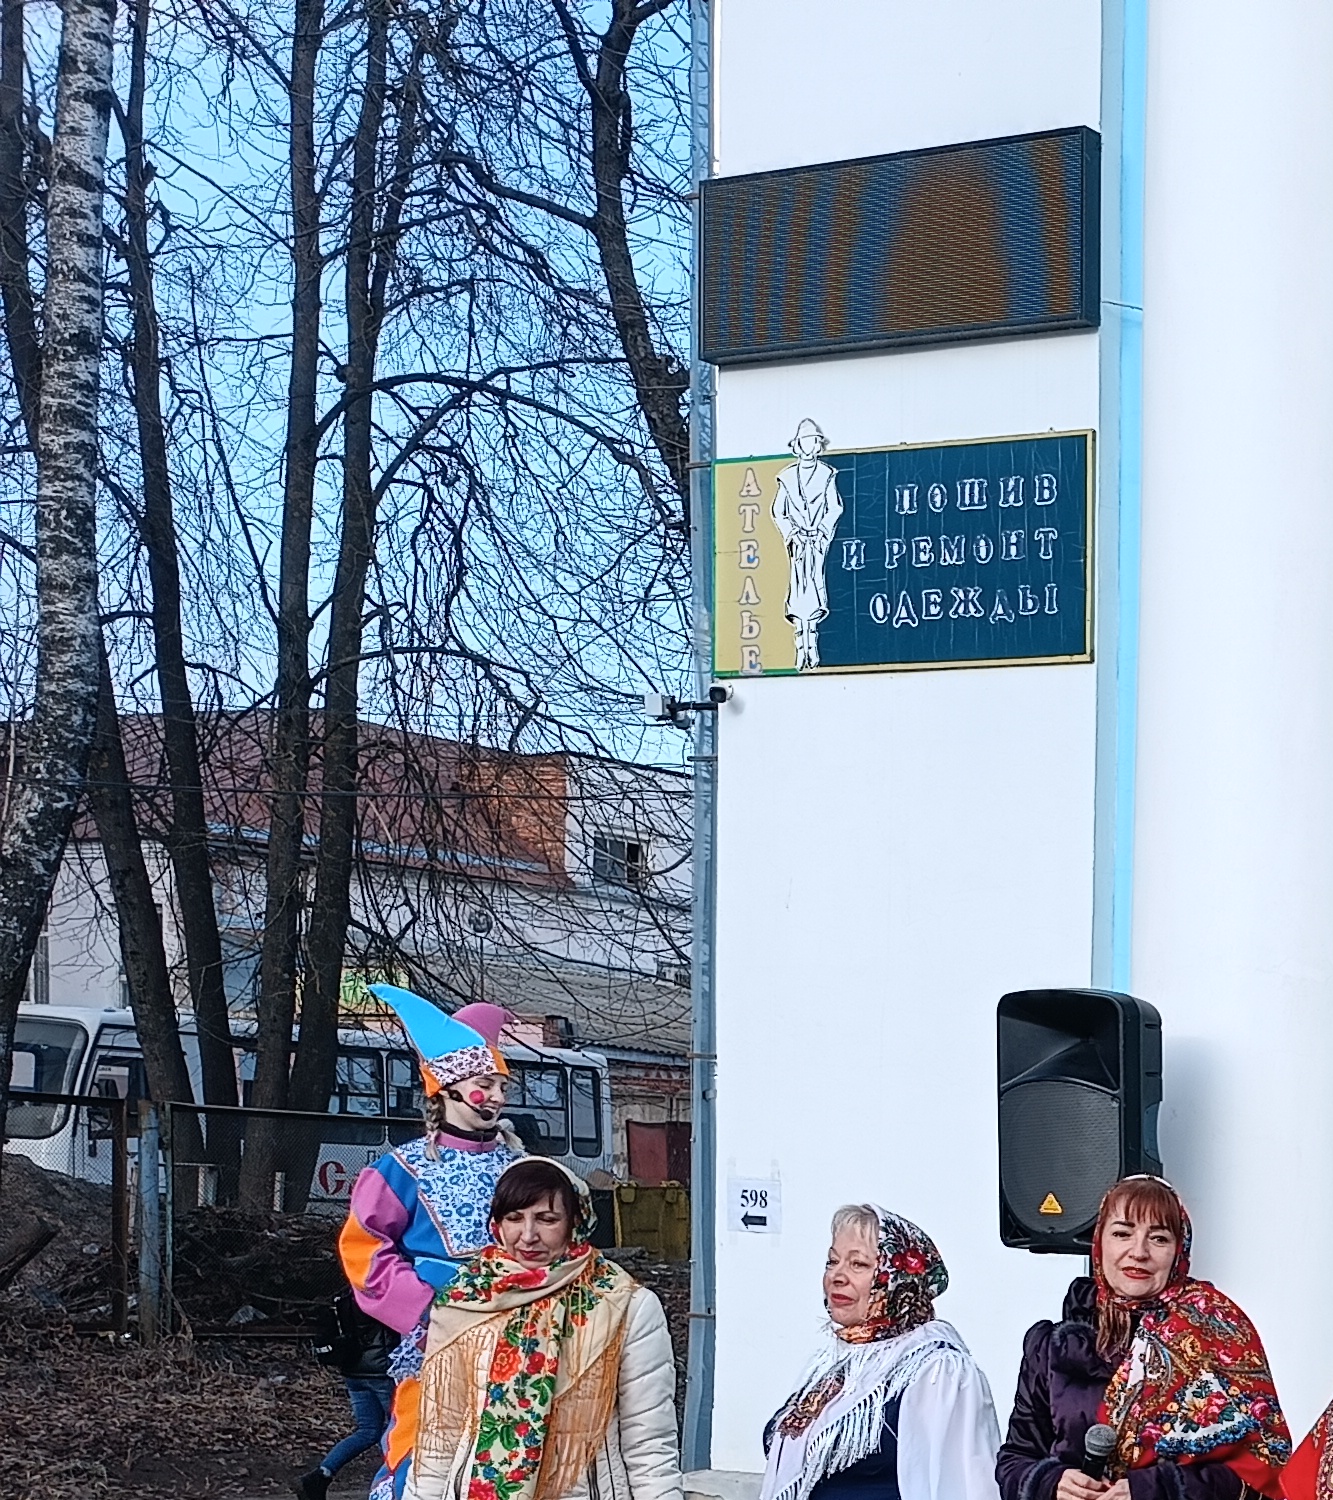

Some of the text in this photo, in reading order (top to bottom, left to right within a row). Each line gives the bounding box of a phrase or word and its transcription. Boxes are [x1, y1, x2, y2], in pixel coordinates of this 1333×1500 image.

[894, 473, 1058, 514] ПОШИВ
[841, 528, 1058, 570] И РЕМОНТ
[738, 467, 763, 675] АТЕЛЬЕ
[869, 583, 1058, 628] ОДЕЖДЫ
[740, 1189, 768, 1208] 598
